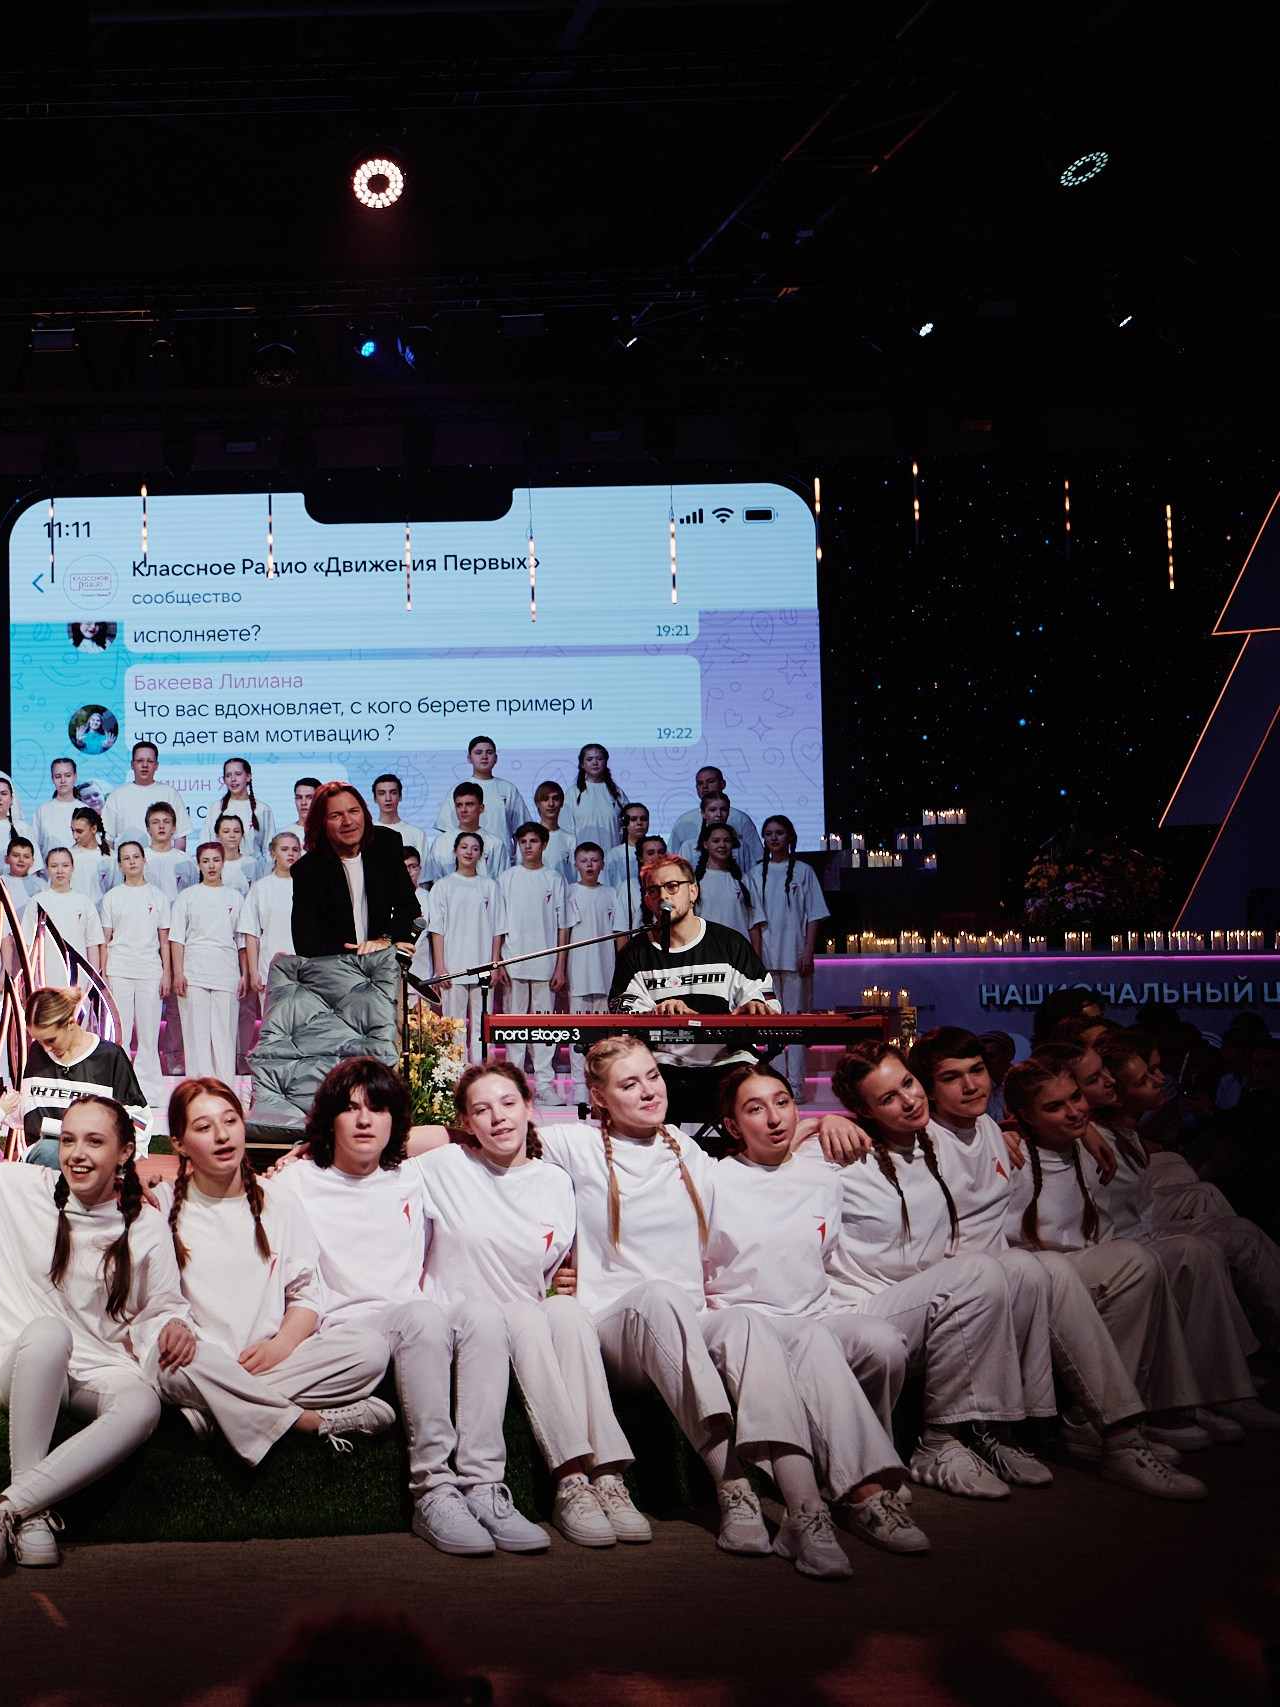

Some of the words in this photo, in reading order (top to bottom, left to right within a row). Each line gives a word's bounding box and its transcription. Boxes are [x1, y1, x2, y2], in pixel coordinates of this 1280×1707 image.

[132, 558, 236, 577] Классное
[242, 558, 308, 578] Радио
[313, 556, 437, 579] «Движения
[443, 554, 540, 575] Первых»
[132, 590, 242, 606] сообщество
[133, 624, 261, 643] исполняете?
[656, 624, 691, 637] 19:21
[134, 675, 213, 691] Бакеева
[218, 673, 304, 690] Лилиана
[134, 701, 170, 718] Что
[175, 704, 210, 718] вас
[214, 701, 345, 720] вдохновляет,
[350, 701, 362, 715] с
[368, 700, 412, 715] кого
[417, 696, 491, 717] берете
[496, 697, 577, 716] пример
[581, 698, 593, 712] и
[134, 731, 168, 744] что
[172, 730, 219, 747] дает
[223, 730, 260, 744] вам
[265, 727, 380, 746] мотивацию
[384, 724, 396, 742] ?
[656, 727, 693, 740] 19:22
[494, 1027, 529, 1041] nord
[530, 1027, 571, 1043] stage
[571, 1028, 581, 1041] 3
